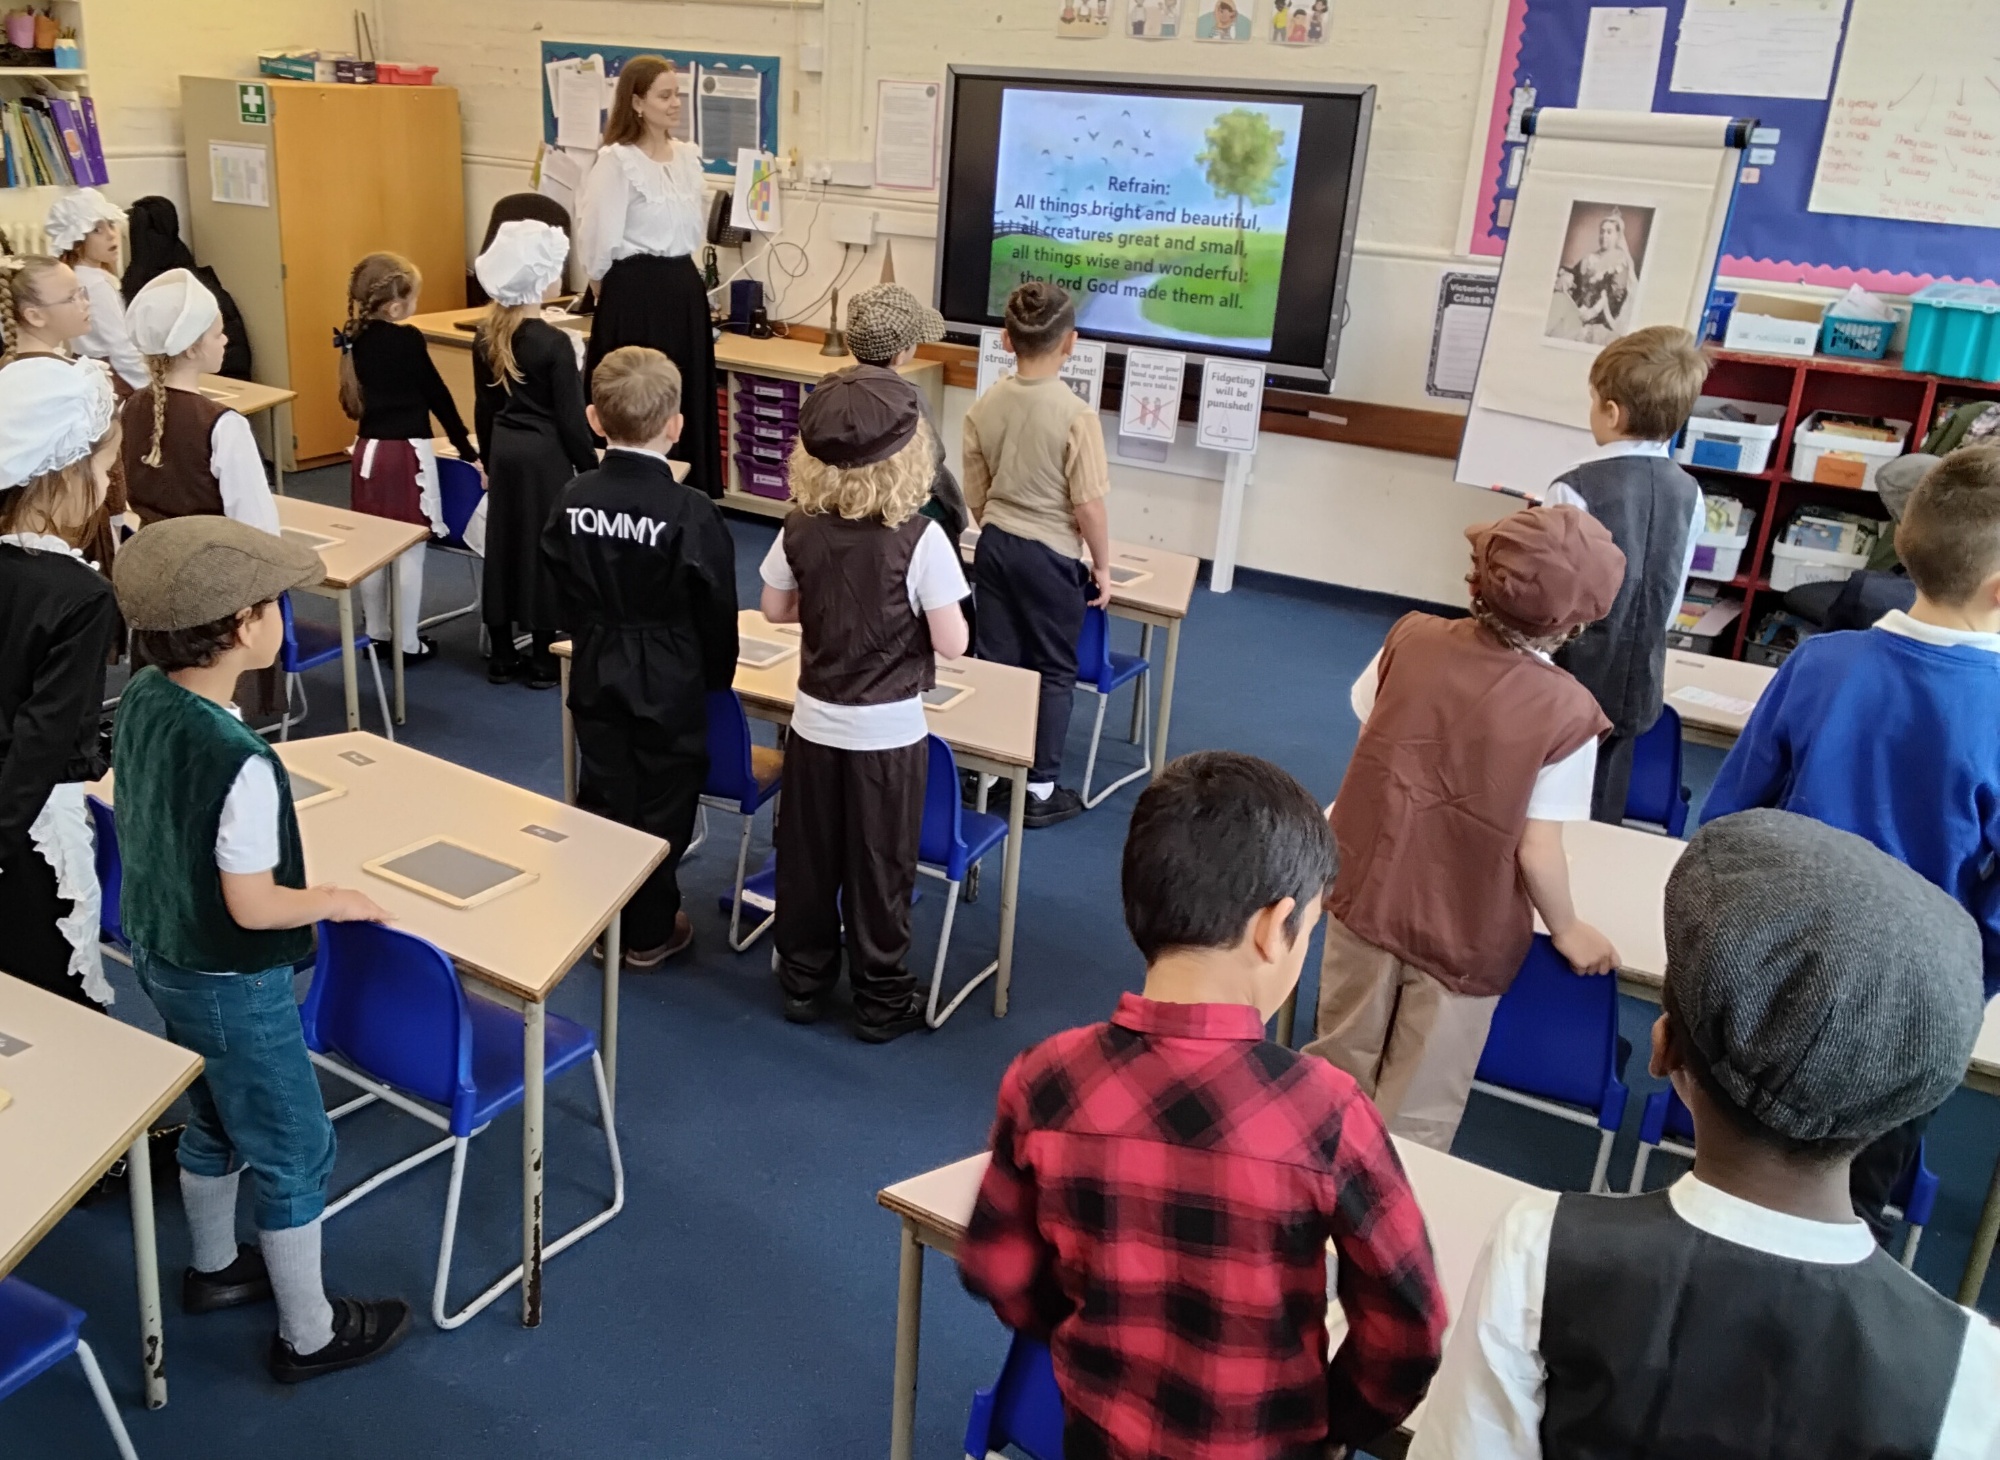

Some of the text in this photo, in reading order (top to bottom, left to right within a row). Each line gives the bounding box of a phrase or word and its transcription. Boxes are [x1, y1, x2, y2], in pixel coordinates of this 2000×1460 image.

[1108, 176, 1171, 196] Refrain:
[1014, 194, 1262, 233] All things bright and beautiful,
[1021, 220, 1249, 259] all creatures great and small,
[1012, 244, 1249, 283] all things wise and wonderful:
[1020, 270, 1044, 284] the
[1087, 278, 1119, 296] God
[1123, 282, 1168, 300] made
[1172, 287, 1214, 305] them
[1219, 292, 1244, 310] all.
[1450, 283, 1490, 294] Victorian
[1453, 293, 1482, 304] Class
[984, 353, 1017, 368] straig
[1068, 354, 1093, 363] yes to
[1071, 364, 1097, 376] front!
[1211, 371, 1256, 388] Fidgeting
[1216, 387, 1248, 398] will be
[1207, 399, 1254, 412] punished!
[566, 507, 667, 547] TOMMY
